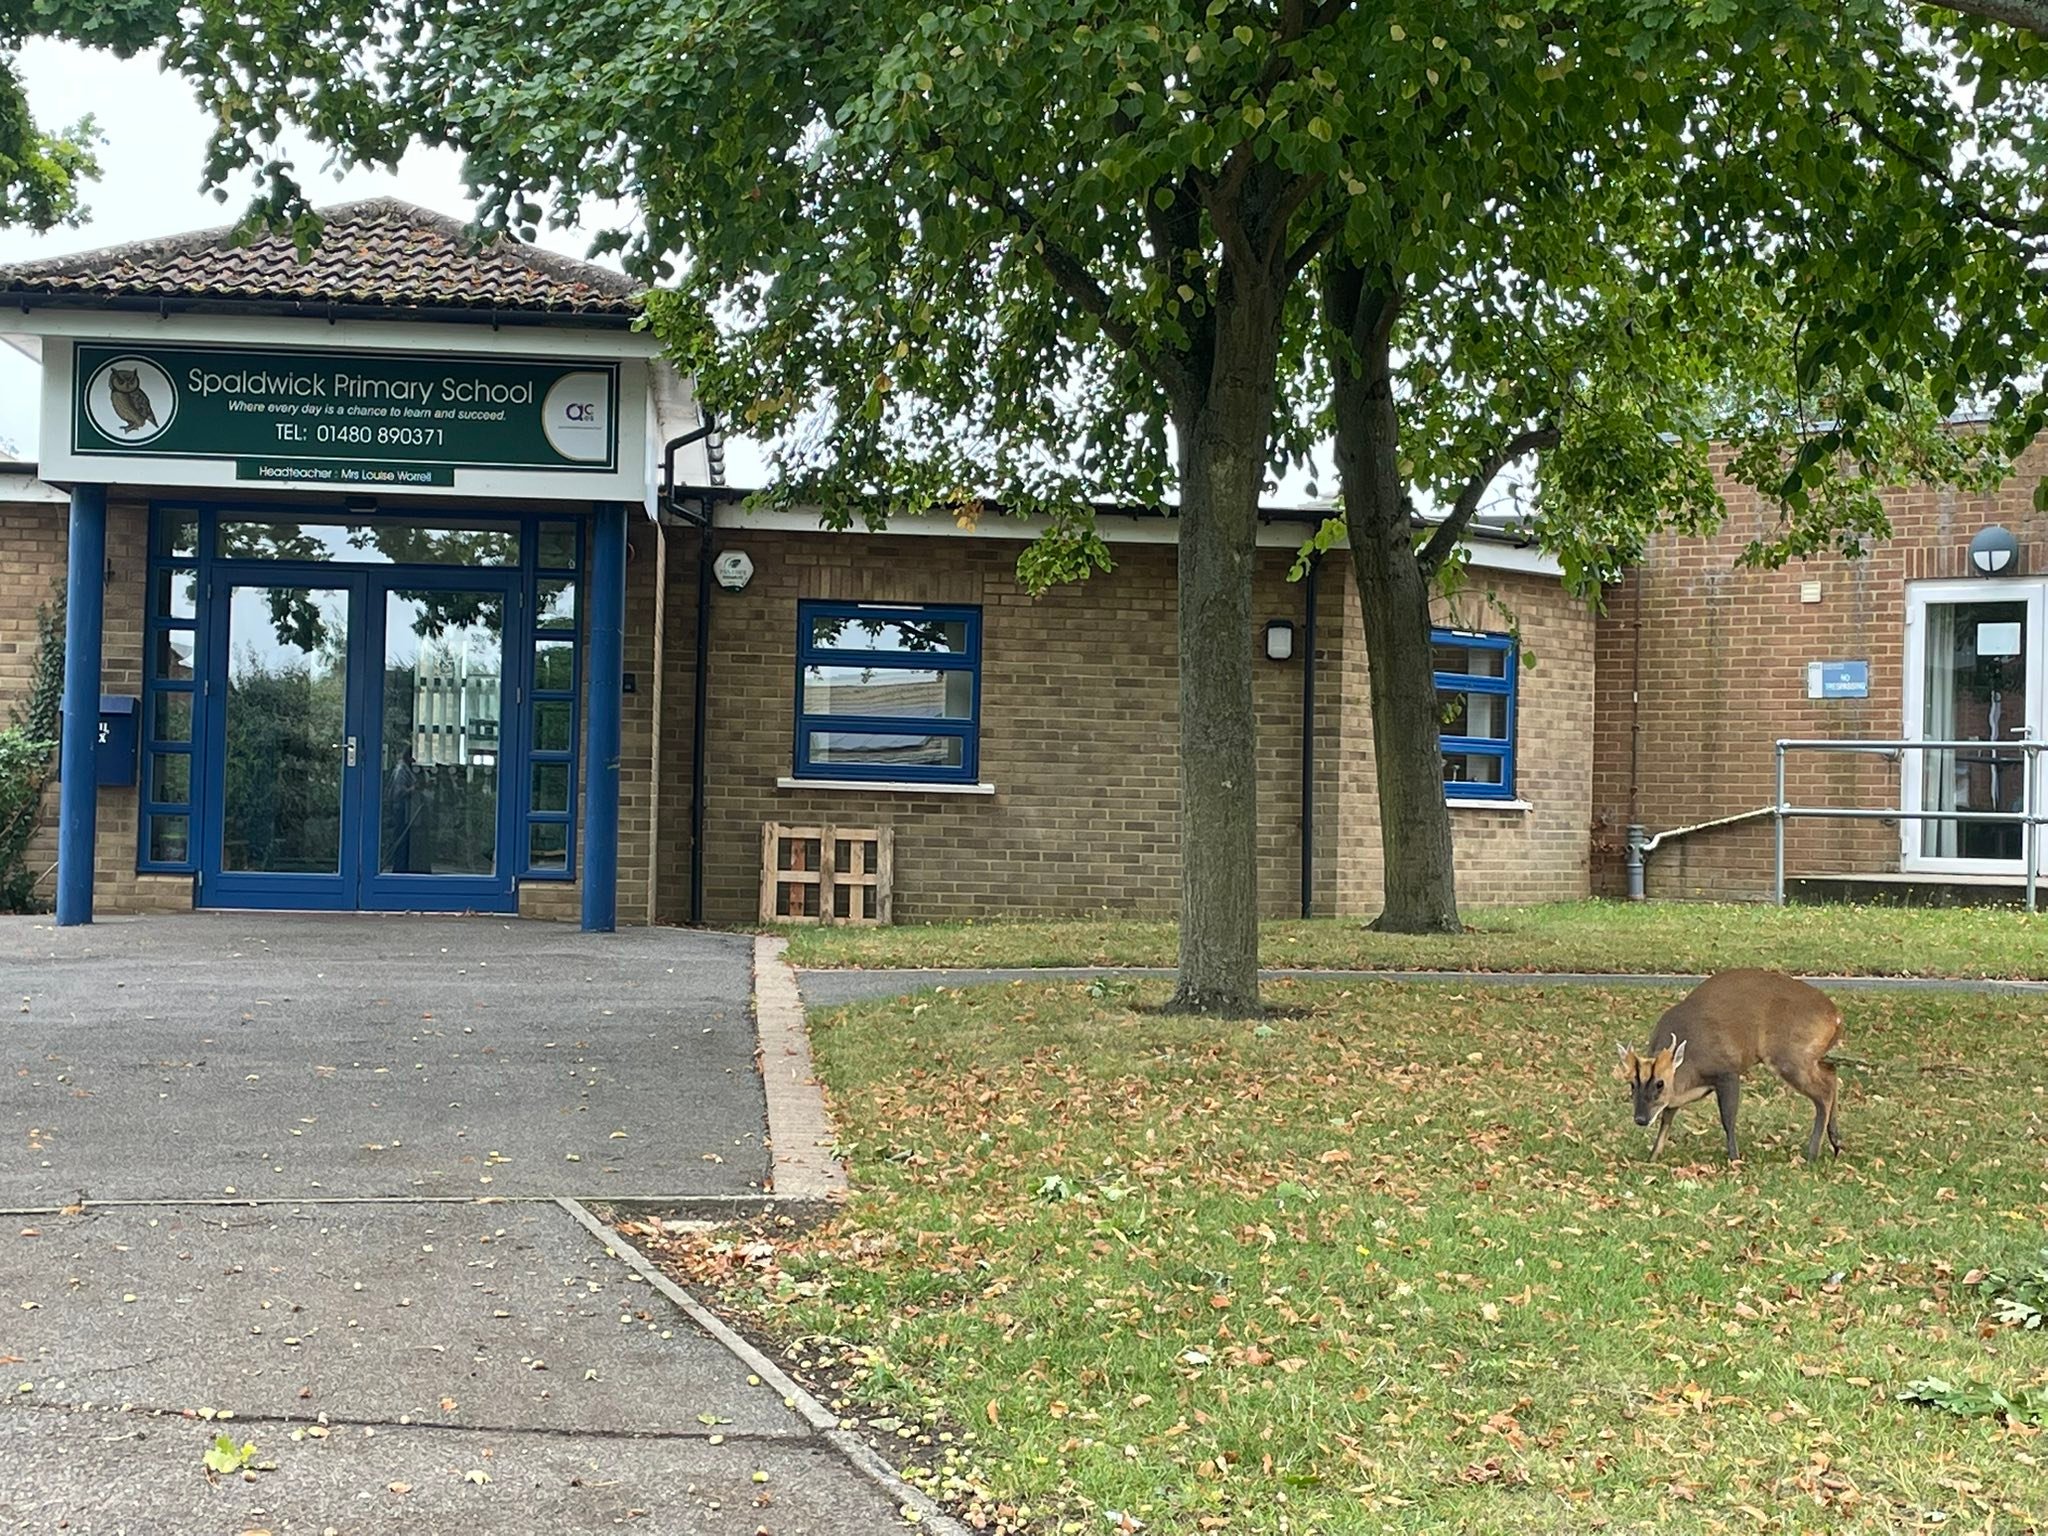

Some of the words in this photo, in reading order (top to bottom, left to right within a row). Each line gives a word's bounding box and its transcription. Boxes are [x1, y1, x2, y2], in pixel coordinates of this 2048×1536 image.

[188, 367, 326, 397] Spaldwick
[334, 373, 434, 405] Primary
[441, 377, 533, 404] School
[228, 400, 265, 412] Where
[267, 404, 299, 416] every
[301, 404, 322, 416] day
[324, 404, 334, 415] is
[336, 406, 344, 415] a
[346, 405, 387, 417] chance
[389, 406, 401, 417] to
[403, 406, 431, 418] learn
[433, 408, 455, 419] and
[457, 409, 507, 421] succeed.
[275, 423, 307, 441] TEL:
[317, 424, 372, 443] 01480
[377, 426, 443, 445] 890371
[259, 466, 332, 478] Headteacher
[341, 468, 359, 480] Mrs
[362, 469, 394, 481] Louise
